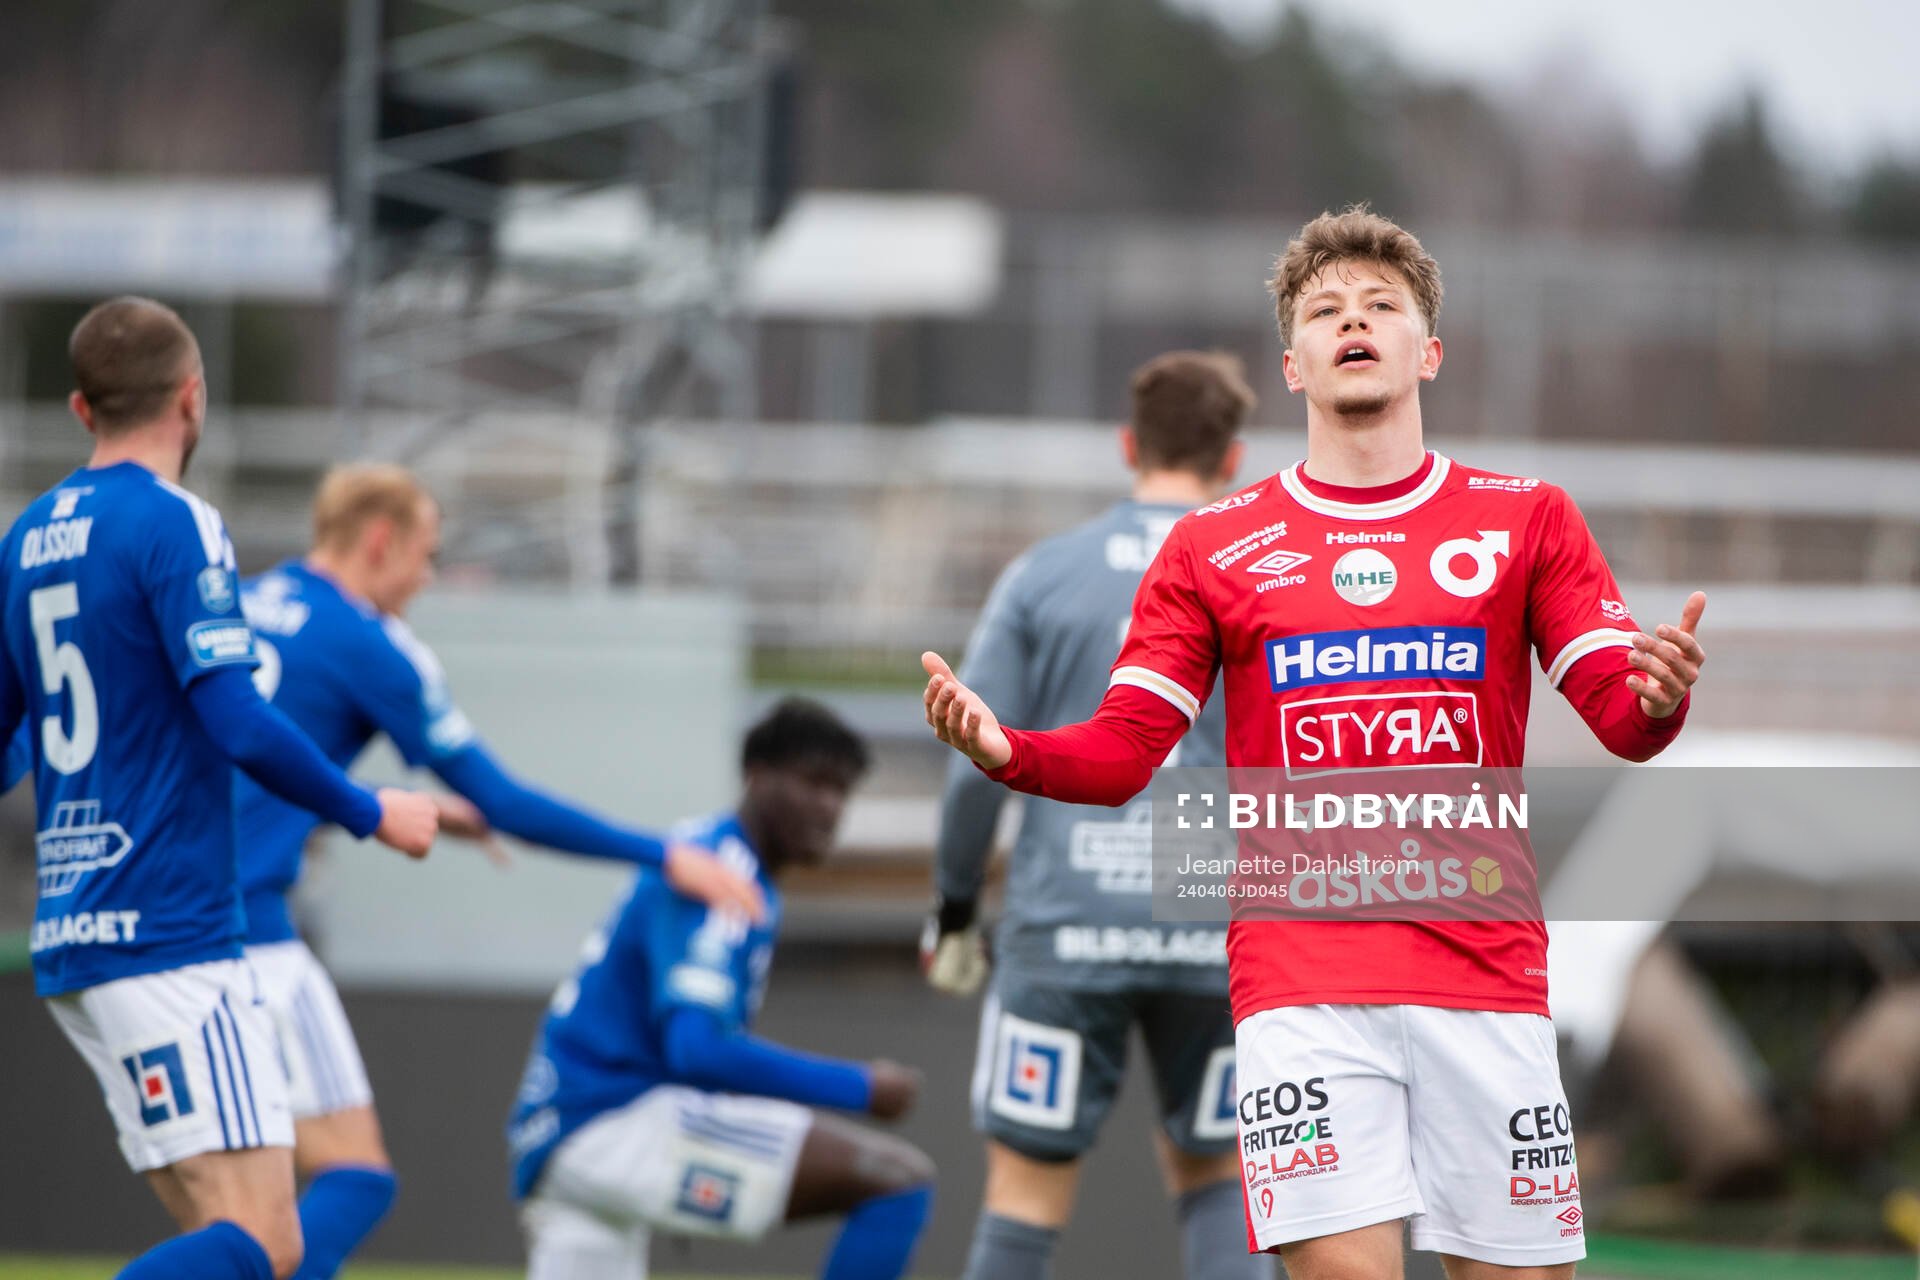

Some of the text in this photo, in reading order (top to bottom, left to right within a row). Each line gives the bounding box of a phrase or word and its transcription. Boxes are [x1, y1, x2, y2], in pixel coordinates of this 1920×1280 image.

[21, 516, 93, 570] OLSSON
[1326, 531, 1406, 545] Helmia
[1256, 575, 1306, 592] umbro
[1334, 571, 1393, 587] MHE
[29, 581, 99, 775] 5
[1273, 632, 1479, 684] Helmia
[1289, 839, 1468, 908] askås
[1240, 1077, 1329, 1125] CEOS
[1509, 1102, 1571, 1142] CEO
[1246, 1143, 1339, 1184] D-LAB
